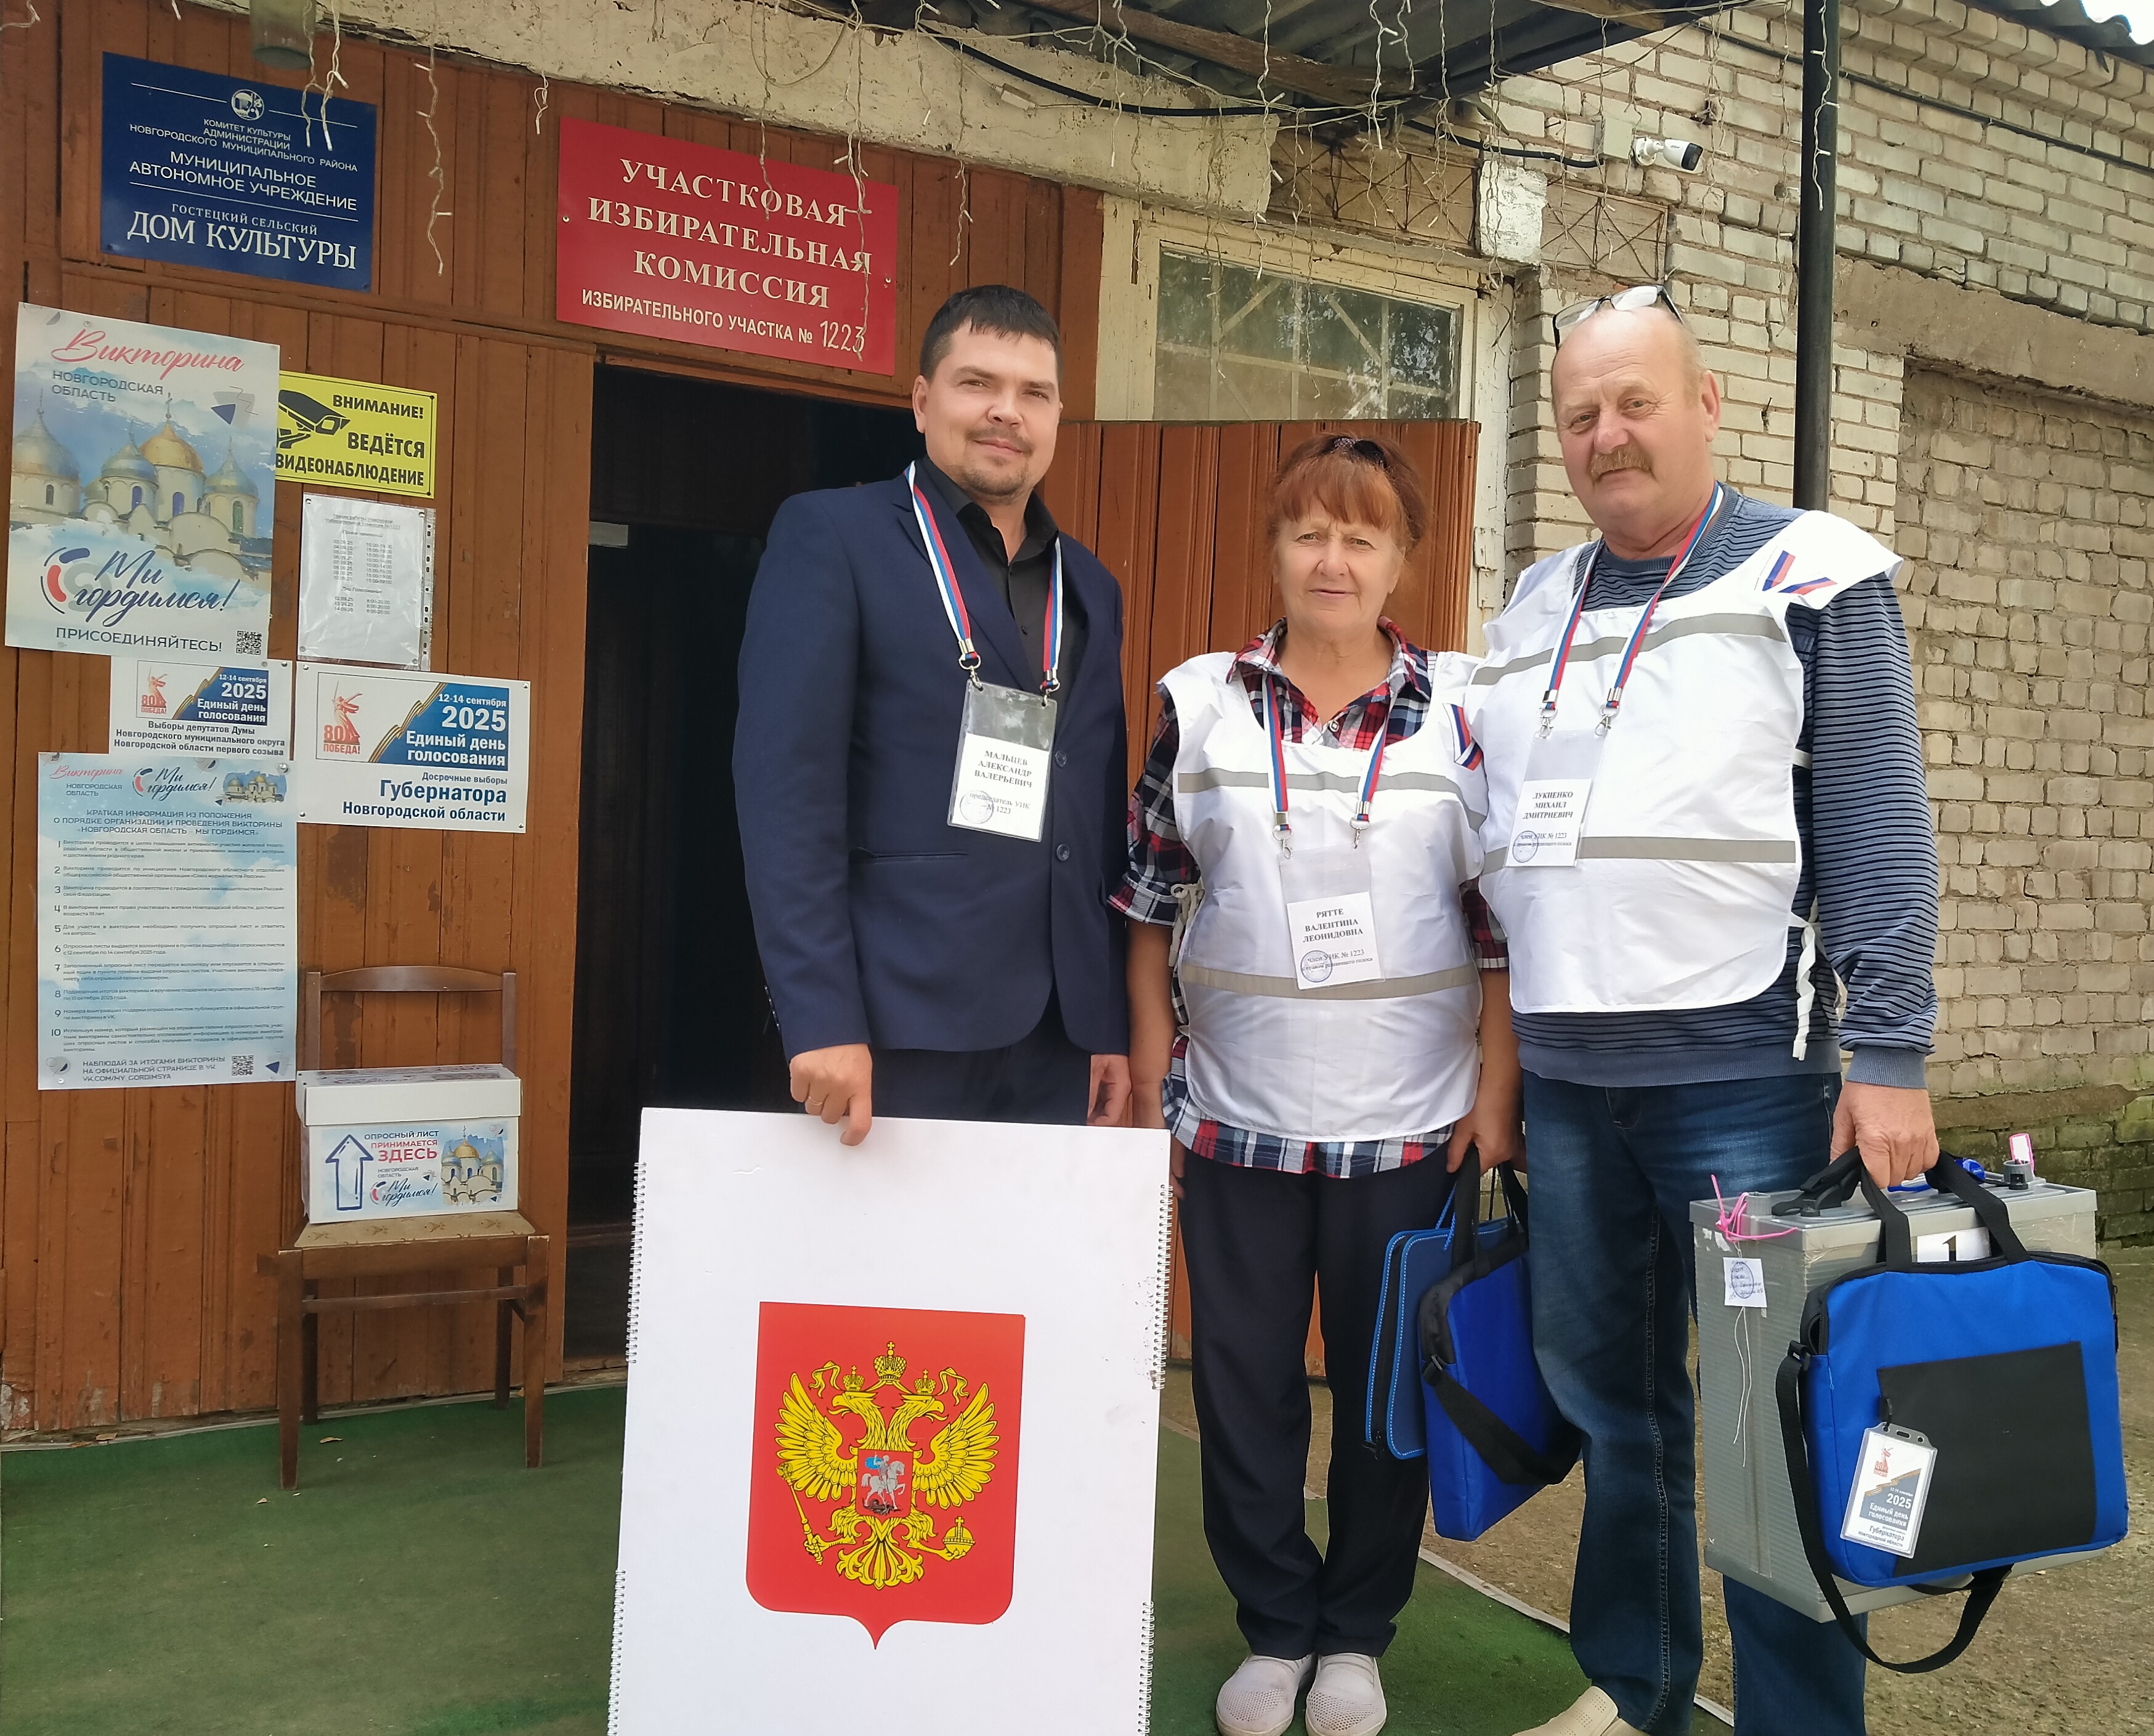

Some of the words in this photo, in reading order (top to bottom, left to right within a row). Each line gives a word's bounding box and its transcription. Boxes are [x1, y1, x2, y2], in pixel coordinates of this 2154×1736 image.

[204, 119, 245, 132] КОМИТЕТ
[247, 126, 291, 141] КУЛЬТУРЫ
[130, 124, 217, 147] НОВГОРОДСКОГО
[222, 142, 315, 164] МУНИЦИПАЛЬНОГО
[320, 158, 357, 172] РАЙОНА
[203, 129, 290, 150] АДМИНИСТРАЦИИ
[171, 152, 316, 188] МУНИЦИПАЛЬНОЕ
[129, 161, 245, 192] АВТОНОМНОЕ
[251, 183, 357, 211] УЧРЕЖДЕНИЕ
[620, 158, 846, 227] УЧАСТКОВАЯ
[172, 204, 248, 225] ГОСТЕЦКИЙ
[252, 217, 317, 235] СЕЛЬСКИЙ
[128, 211, 195, 244] ДОМ
[206, 224, 357, 269] КУЛЬТУРЫ
[588, 197, 872, 275] ИЗБИРАТЕЛЬНАЯ
[633, 250, 829, 308] КОМИССИЯ
[582, 290, 723, 328] ИЗБИРАТЕЛЬНОГО
[729, 315, 793, 341] УЧАСТКА
[798, 329, 813, 344] №
[820, 321, 865, 353] 1223
[51, 329, 245, 379] Викторина
[53, 370, 163, 395] НОВГОРОДСКАЯ
[52, 384, 116, 402] ОБЛАСТЬ
[333, 395, 423, 419] ВНИМАНИЕ!
[348, 432, 424, 458] ВЕДЁТСЯ
[276, 453, 424, 486] ВИДЕОНАБЛЮДЕНИЕ
[74, 579, 240, 627] гордимся!
[56, 627, 222, 652] ПРИСОЕДИНЯЙТЕСЬ!
[221, 683, 267, 700] 2025
[141, 695, 156, 706] 80
[197, 699, 239, 711] Единый
[241, 702, 266, 712] день
[439, 694, 464, 703] 12-14
[466, 696, 506, 708] сентября
[198, 710, 265, 722] голосования
[442, 706, 506, 731] 2025
[148, 721, 184, 731] Выборы
[186, 724, 229, 733] депутатов
[232, 726, 255, 734] Думы
[323, 725, 347, 742] 80
[116, 729, 182, 740] Новгородского
[185, 734, 255, 745] муниципального
[407, 731, 466, 748] Единый
[470, 736, 506, 751] день
[115, 739, 176, 750] Новгородской
[179, 744, 214, 752] области
[216, 747, 250, 755] первого
[323, 743, 360, 754] ПОБЕДА!
[407, 749, 505, 766] голосования
[985, 750, 1027, 765] МАЛЬЦЕВ
[49, 765, 123, 781] Викторина
[978, 760, 1032, 777] АЛЕКСАНДР
[422, 773, 471, 783] Досрочные
[474, 776, 508, 785] выборы
[974, 770, 1032, 787] ВАЛЕРЬЕВИЧ
[147, 777, 217, 801] гордимся!
[380, 779, 507, 806] Губернатора
[343, 801, 445, 819] Новгородской
[449, 809, 506, 822] области
[1523, 811, 1573, 819] ДМИТРИЕВИЧ
[1316, 909, 1343, 918] РЯТТЕ
[1305, 919, 1358, 931] ВАЛЕНТИНА
[1303, 928, 1363, 943] ЛЕОНИДОВНА
[365, 1131, 414, 1140] ОПРОСНЫЙ
[371, 1140, 437, 1148] ПРИНИМАЕТСЯ
[378, 1148, 437, 1163] ЗДЕСЬ
[1942, 1235, 1956, 1261] 1
[1886, 1493, 1911, 1509] 2025
[1868, 1511, 1906, 1527] голосования
[1869, 1503, 1893, 1514] Единый
[1894, 1510, 1908, 1520] день
[1869, 1525, 1905, 1541] Губернатора
